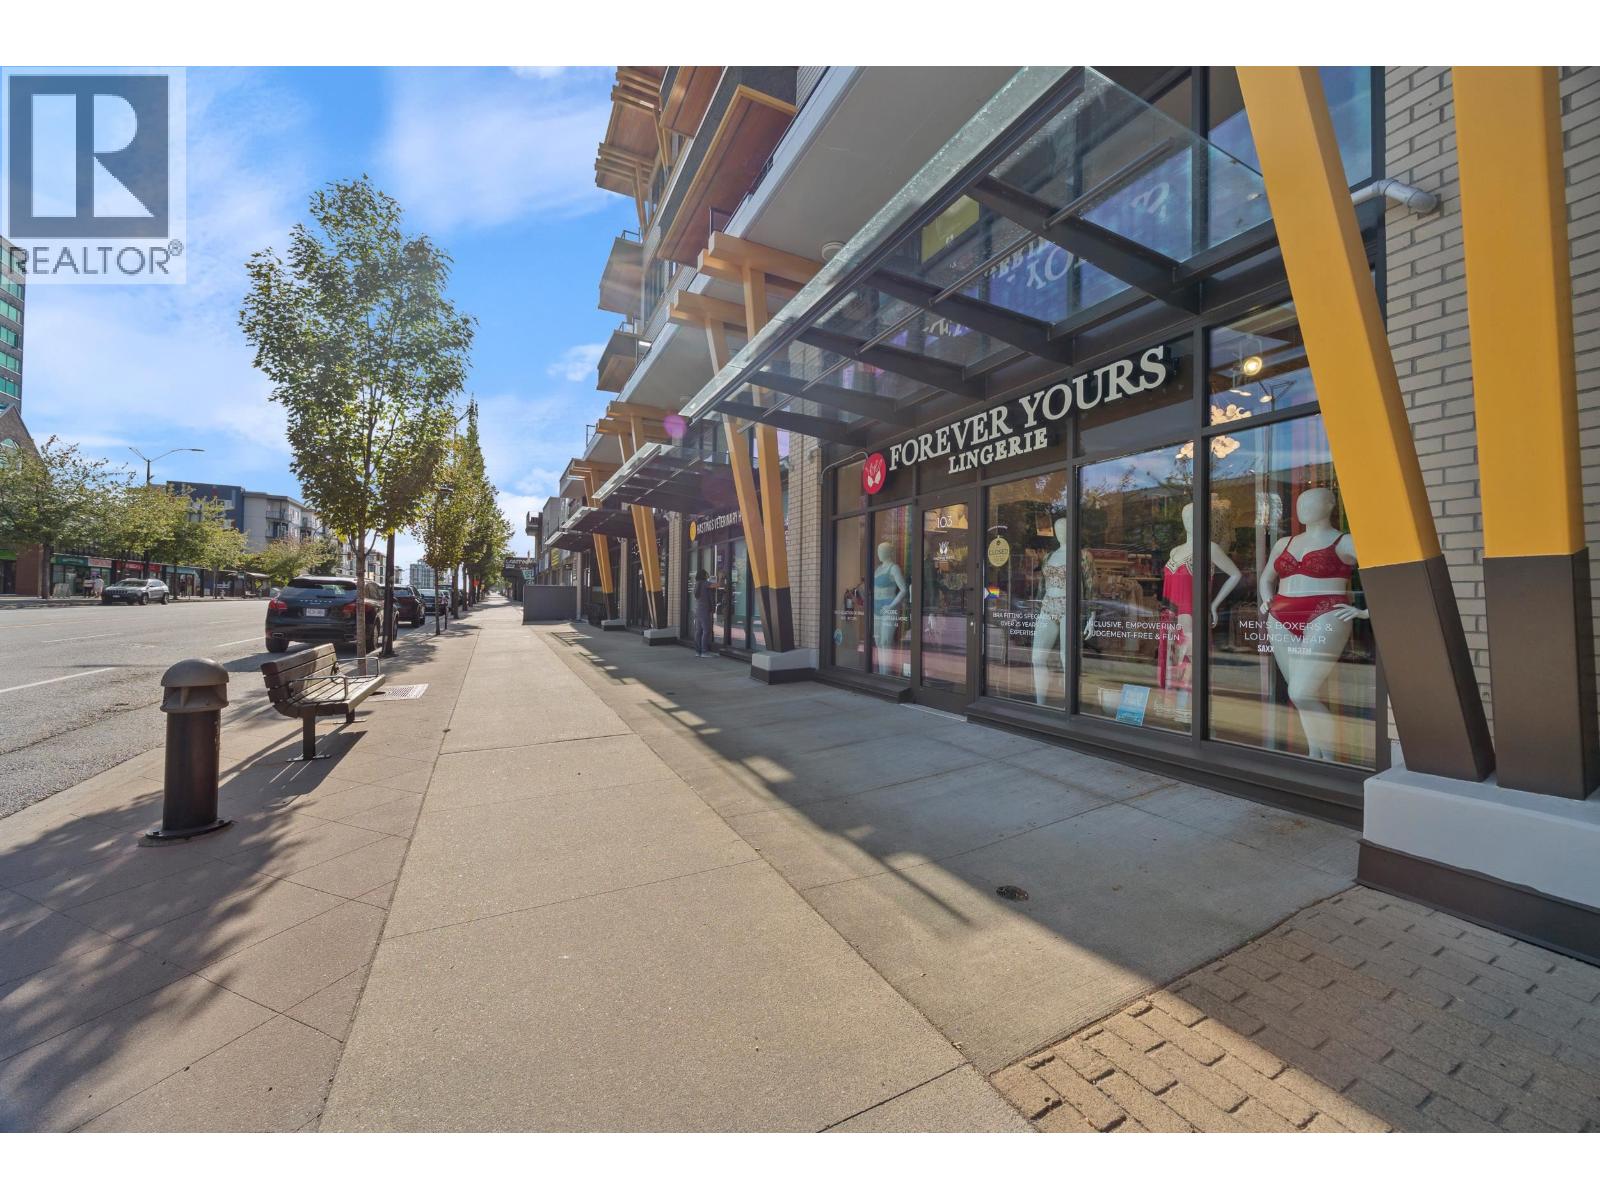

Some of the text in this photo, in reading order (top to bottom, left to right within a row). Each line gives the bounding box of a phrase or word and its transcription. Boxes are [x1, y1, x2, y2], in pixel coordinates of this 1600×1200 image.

[888, 344, 1167, 472] FOREVER YOURS
[948, 427, 1048, 475] LINGERIE
[937, 515, 953, 528] 103
[1239, 620, 1333, 632] MEN'S BOXERS &
[1089, 630, 1153, 640] UDGEMENT-FREE
[1163, 633, 1180, 641] FUN
[1244, 632, 1326, 644] LOUNGEWEAR
[1257, 644, 1275, 653] SAXX
